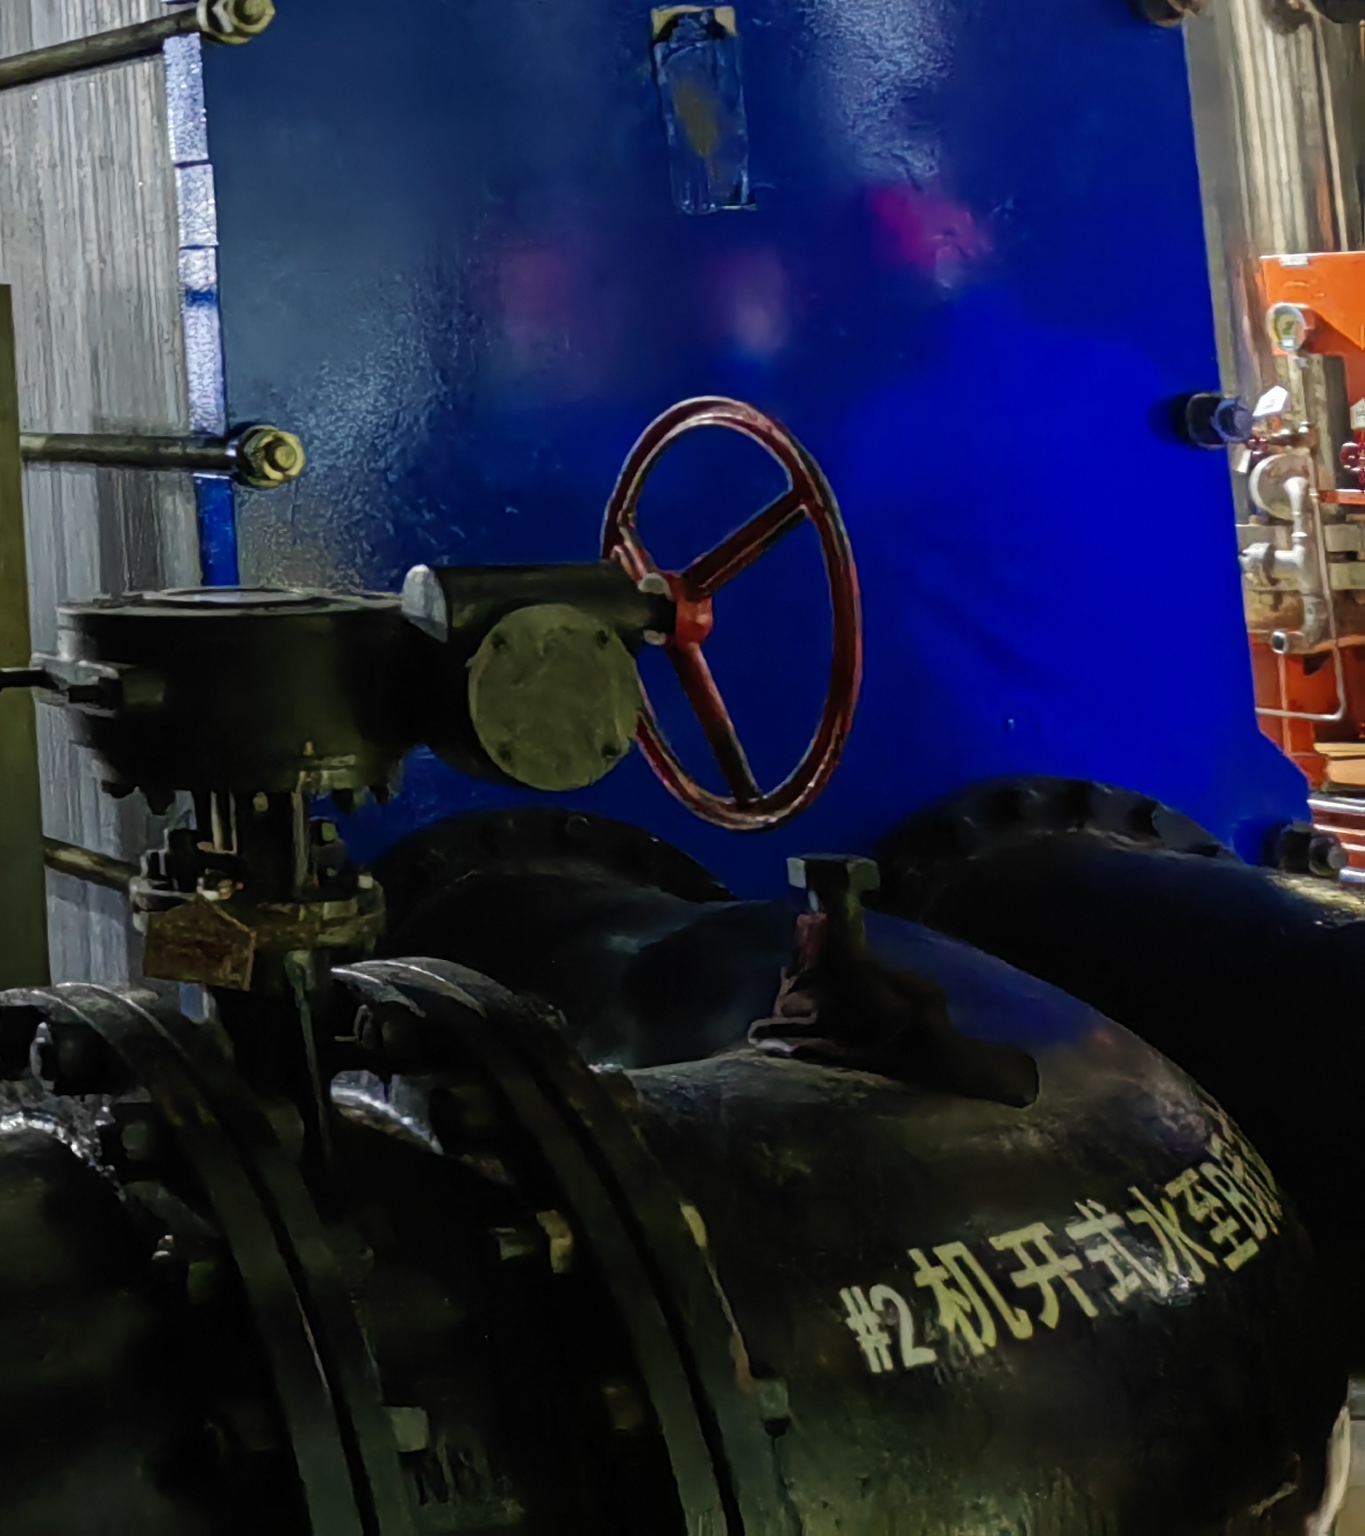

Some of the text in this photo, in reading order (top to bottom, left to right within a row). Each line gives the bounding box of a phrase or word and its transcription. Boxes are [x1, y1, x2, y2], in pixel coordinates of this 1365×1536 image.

[839, 1131, 1283, 1374] #2机开式水至B
